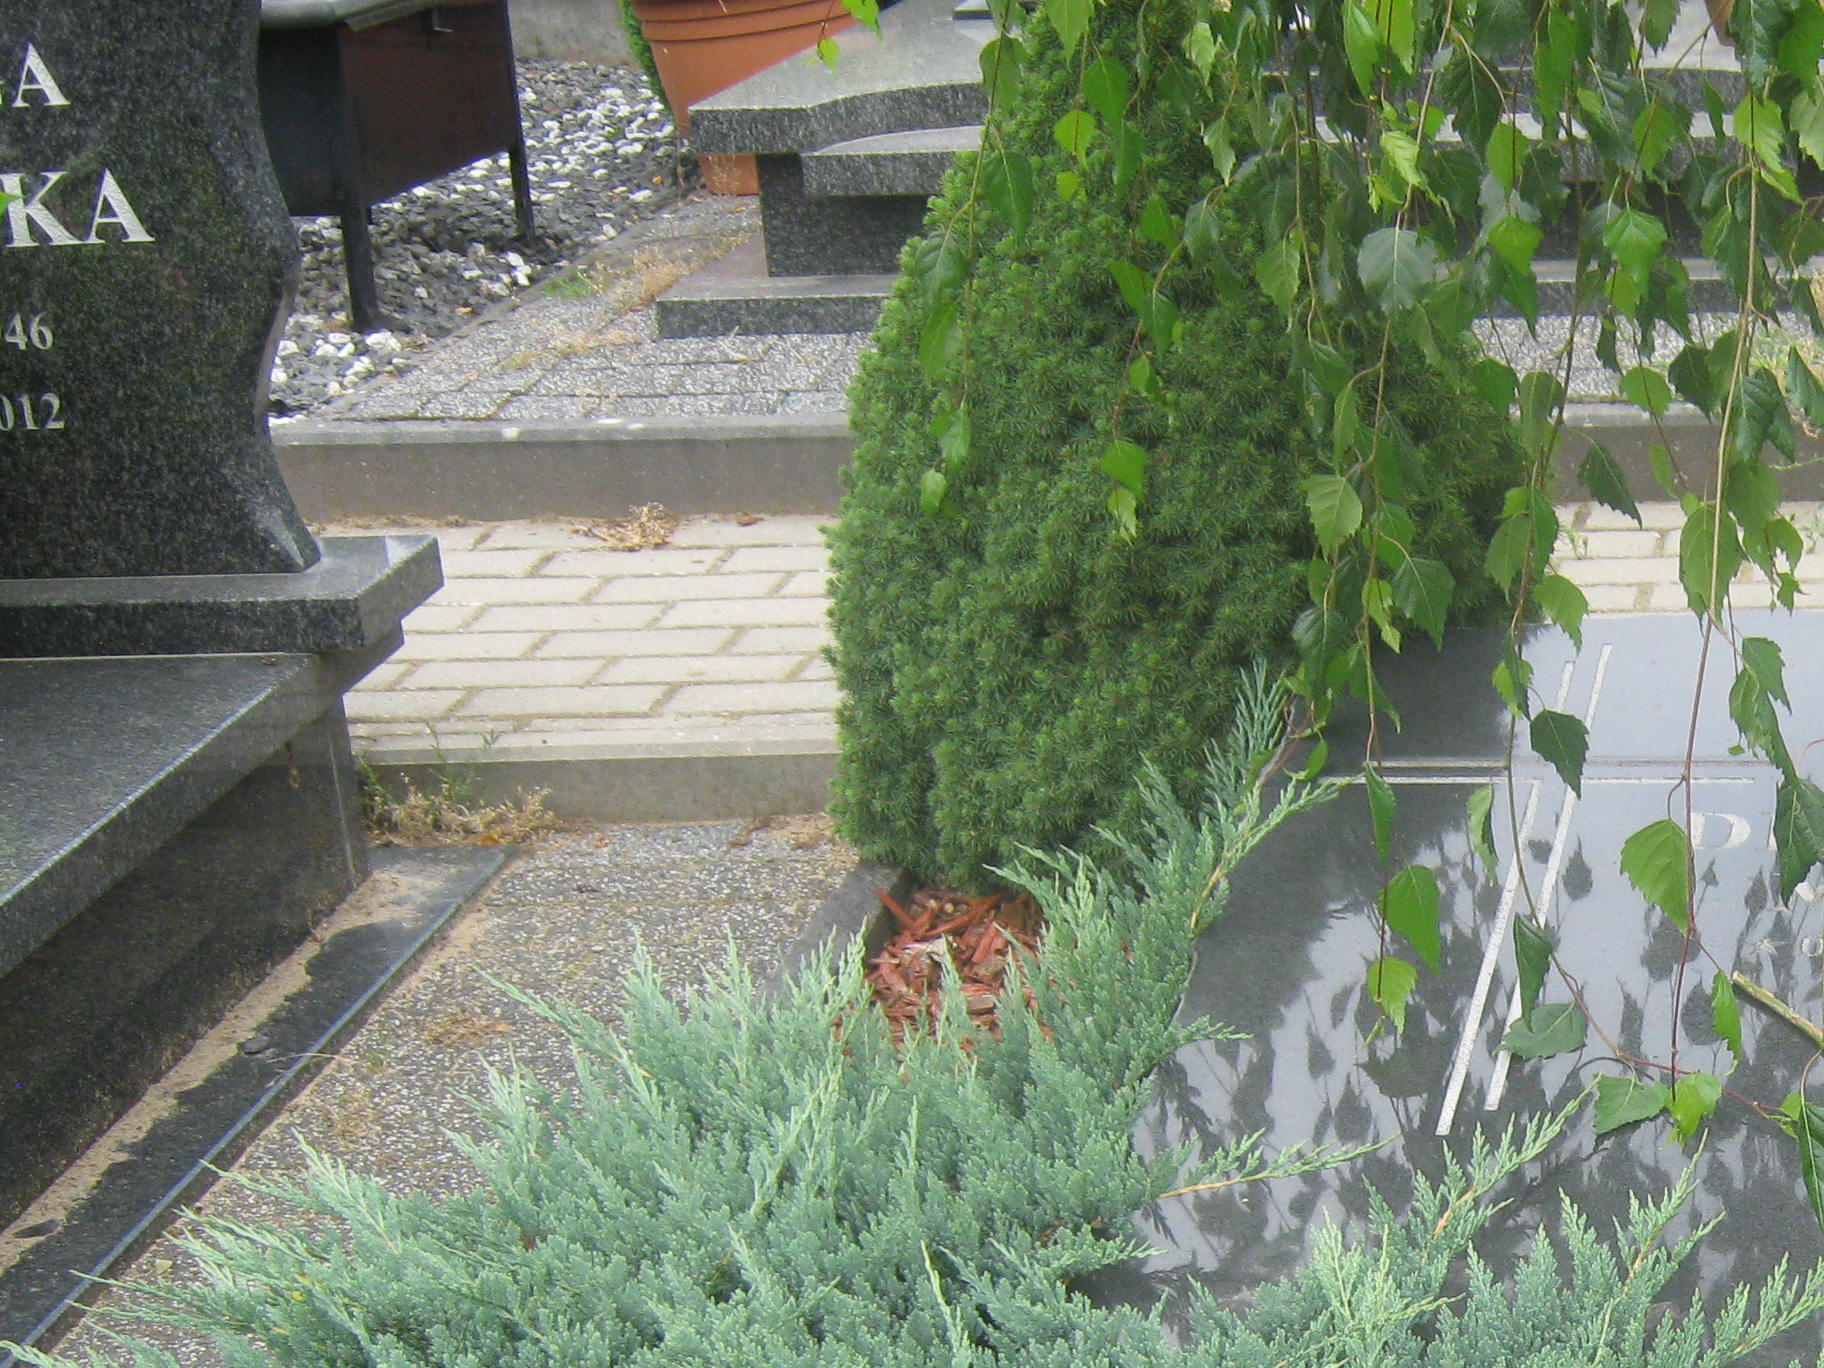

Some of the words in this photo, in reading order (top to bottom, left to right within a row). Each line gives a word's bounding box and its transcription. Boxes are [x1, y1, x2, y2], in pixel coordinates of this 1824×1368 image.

[0, 41, 71, 107] A
[0, 168, 155, 247] KA
[4, 312, 53, 350] 46
